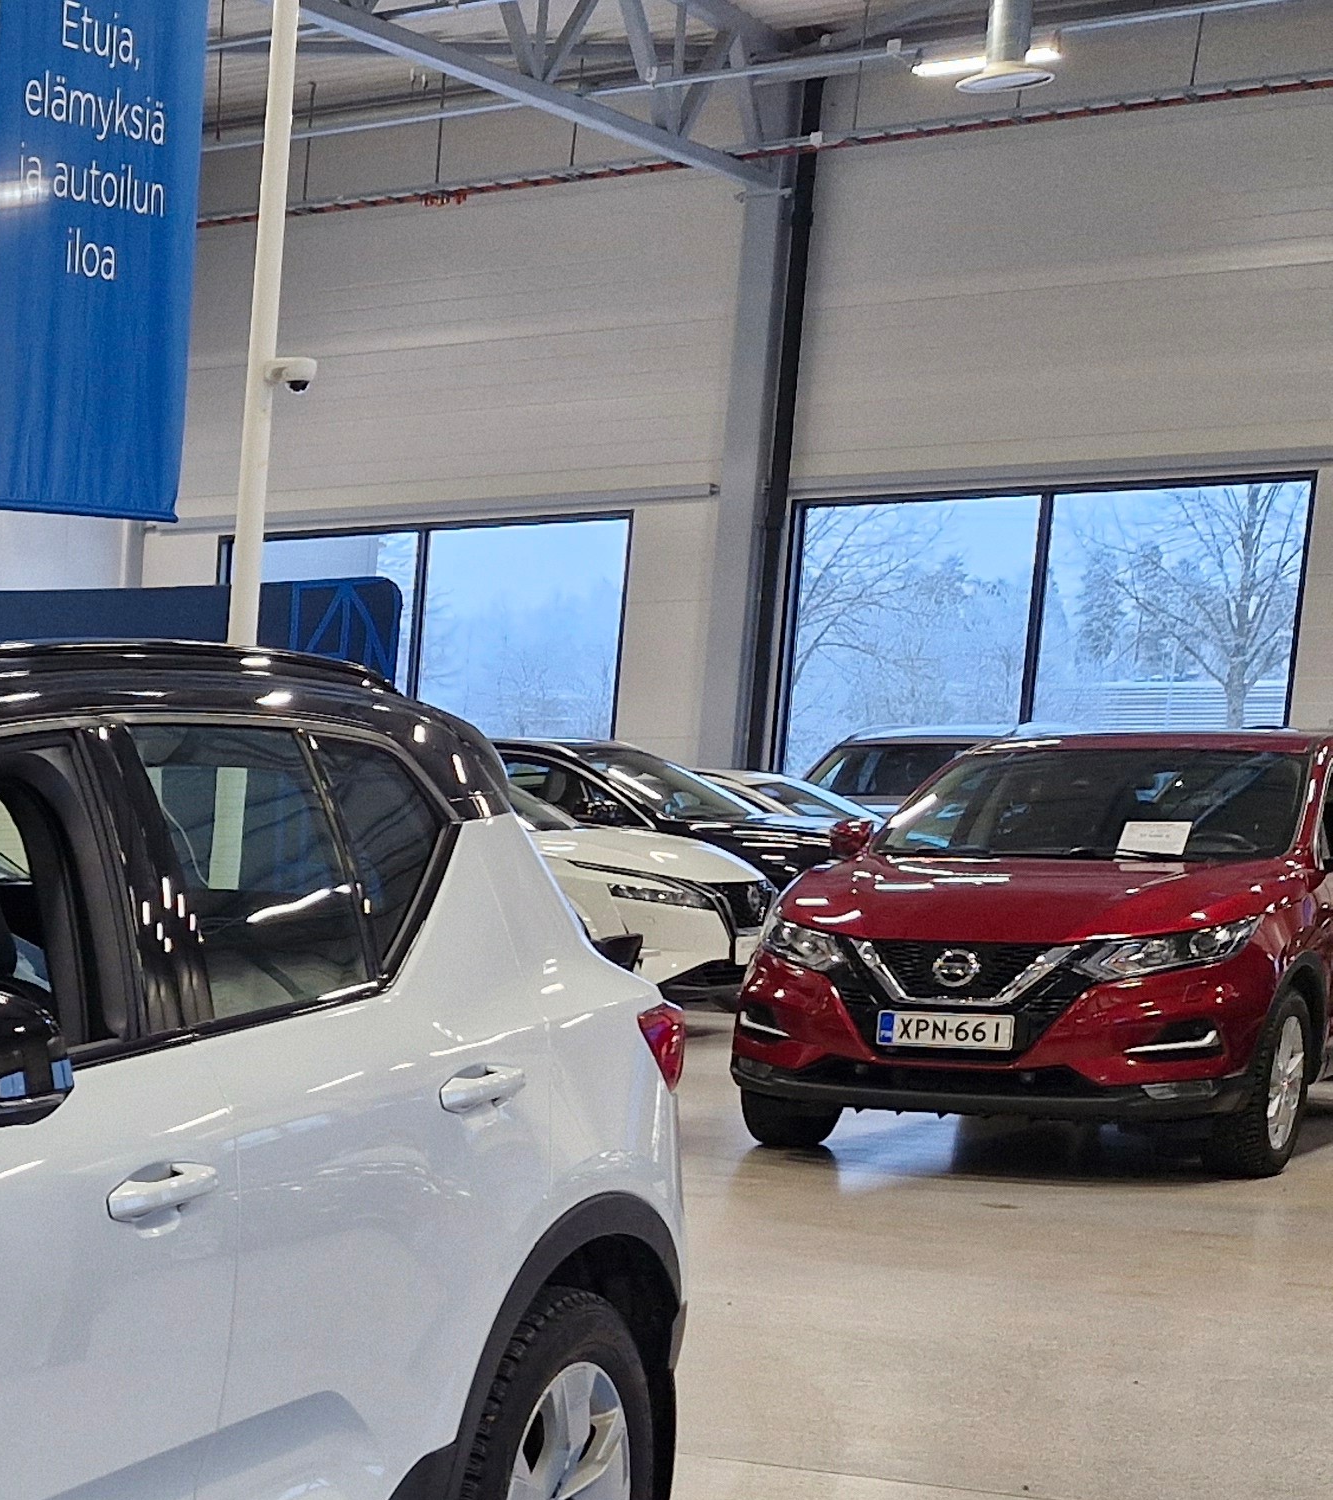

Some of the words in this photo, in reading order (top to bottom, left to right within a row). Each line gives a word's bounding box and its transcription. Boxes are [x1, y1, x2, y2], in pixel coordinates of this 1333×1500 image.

[61, 0, 140, 71] Etuja,
[24, 69, 165, 146] elämyksiä
[18, 141, 43, 199] ja
[53, 160, 164, 218] autoilun
[65, 226, 117, 281] iloa
[898, 1018, 1000, 1043] XPN-661
